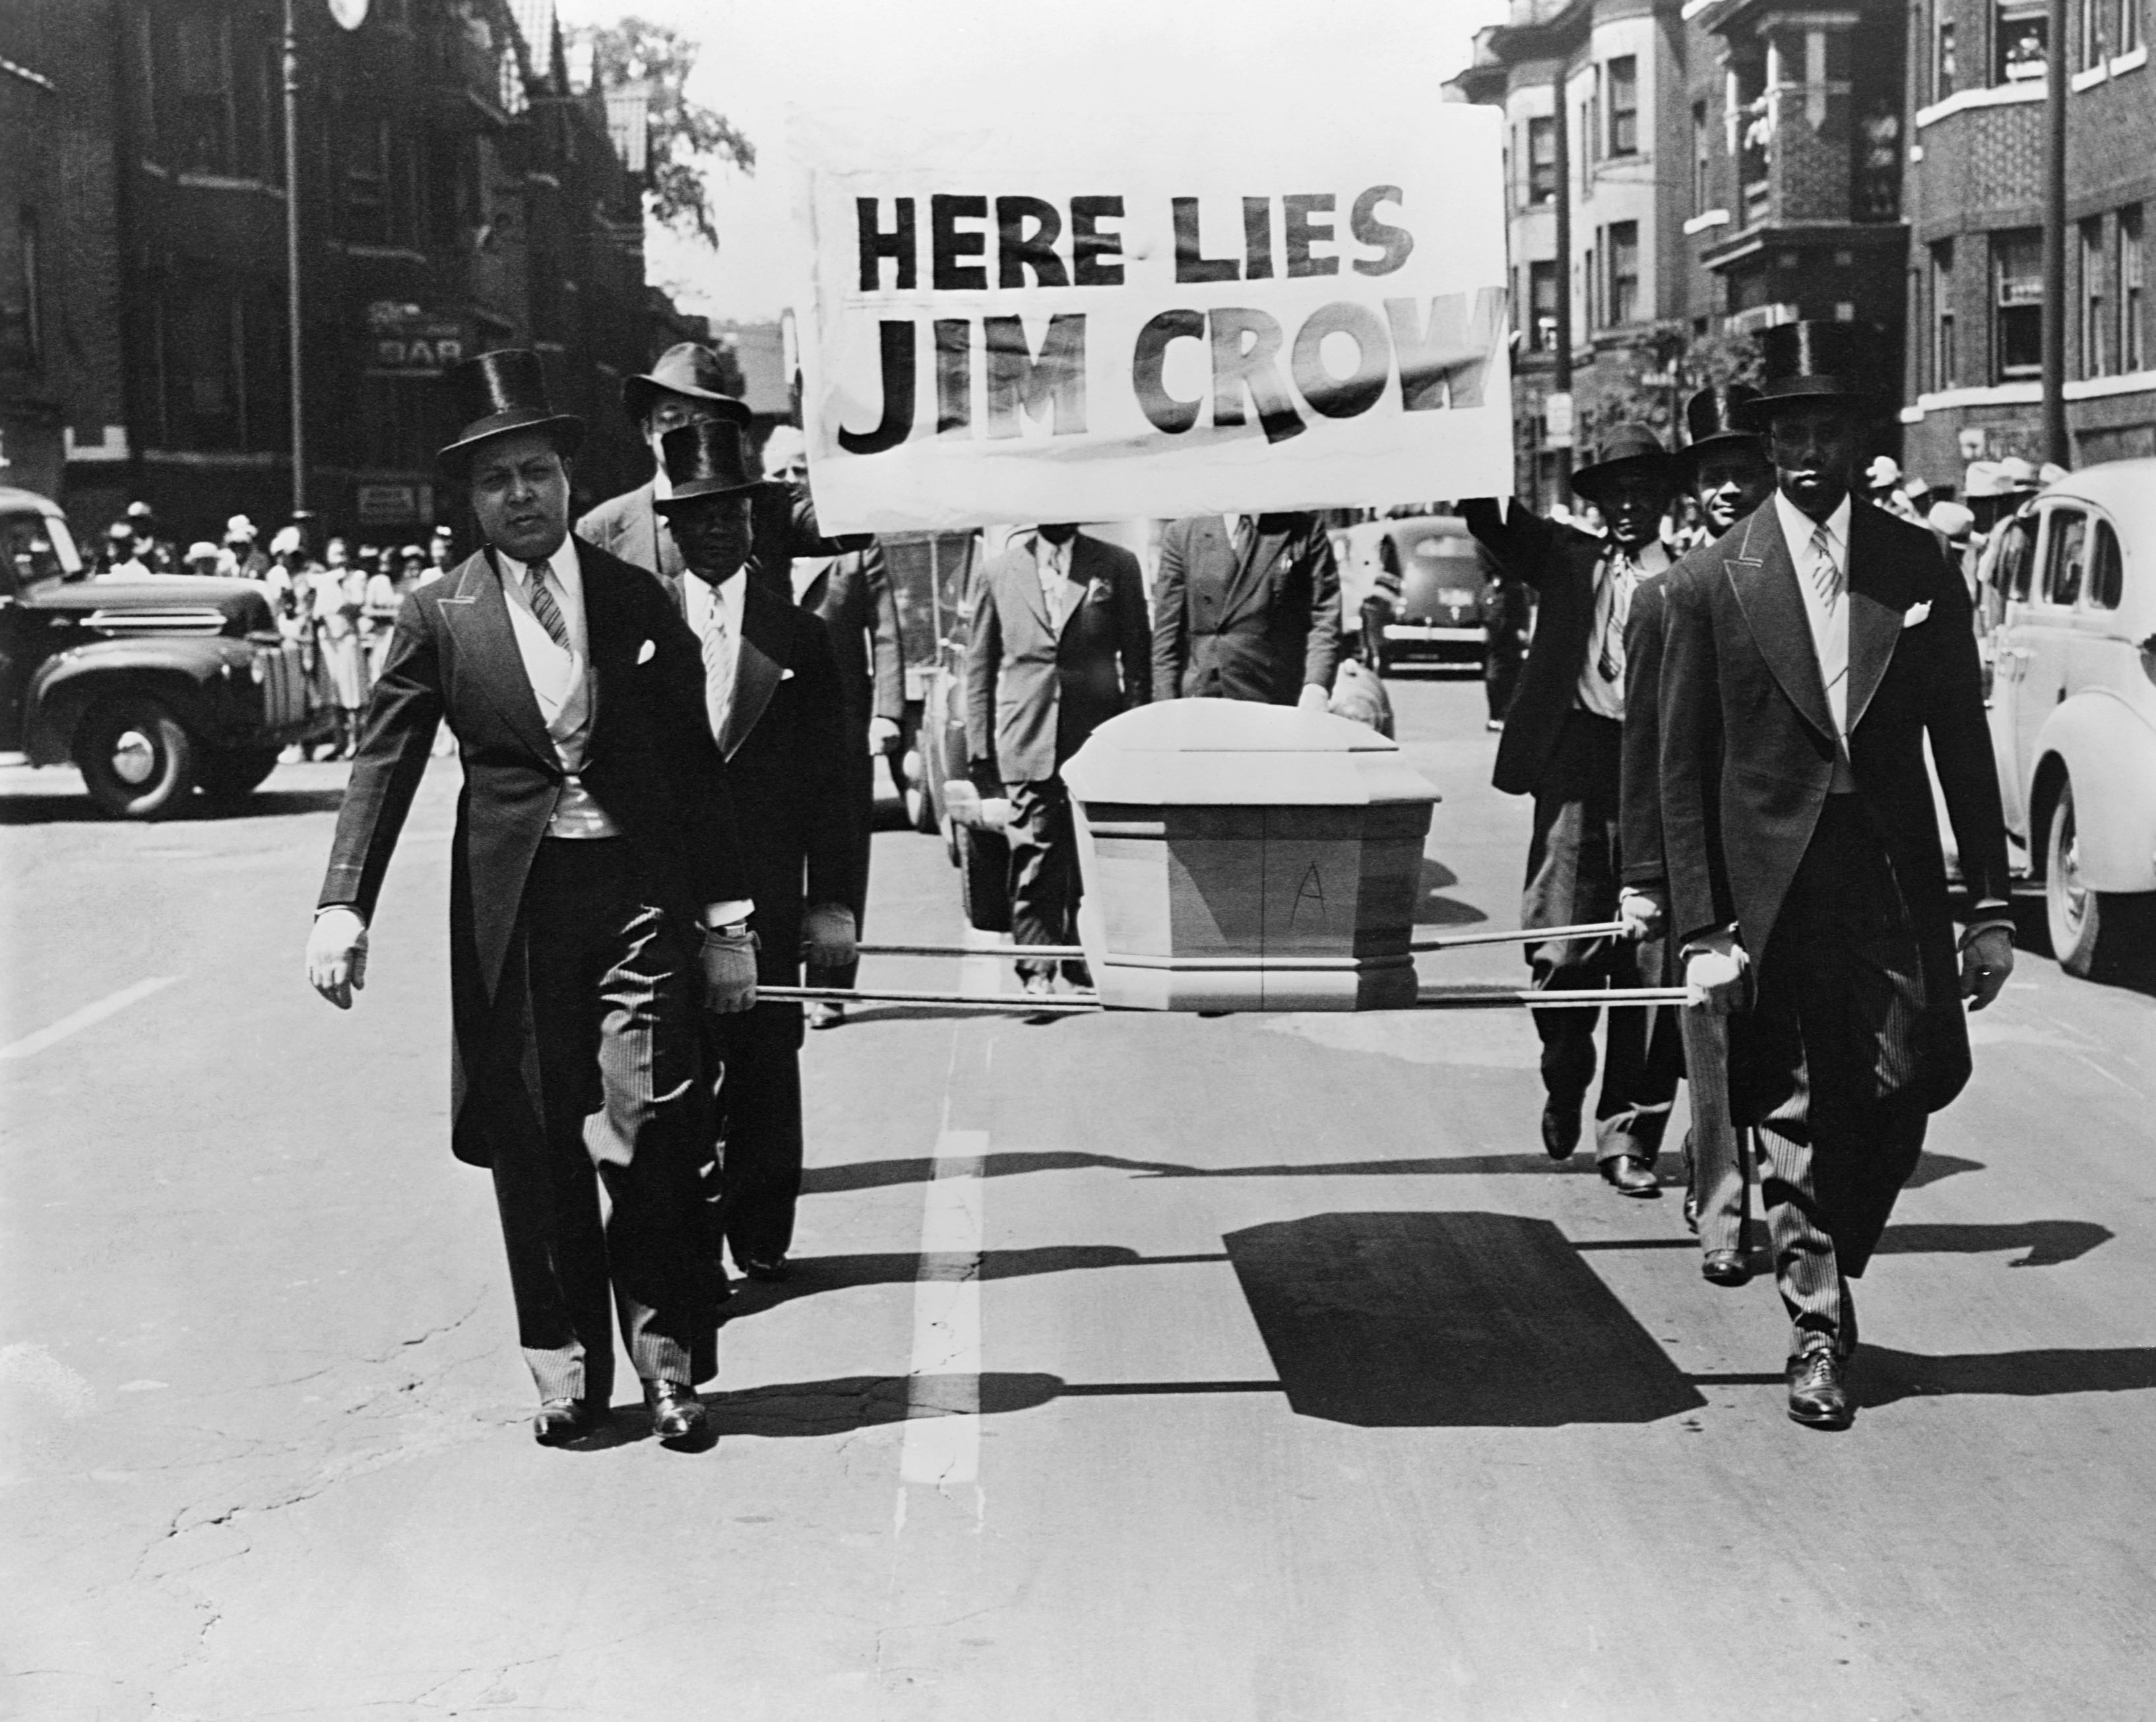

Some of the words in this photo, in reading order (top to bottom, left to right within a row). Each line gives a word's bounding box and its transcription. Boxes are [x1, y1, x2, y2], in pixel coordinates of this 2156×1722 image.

[856, 193, 1126, 292] HERE
[1170, 184, 1414, 284] LIES
[838, 313, 1089, 455] JIM
[1132, 286, 1509, 444] CROW
[1290, 860, 1327, 928] A
